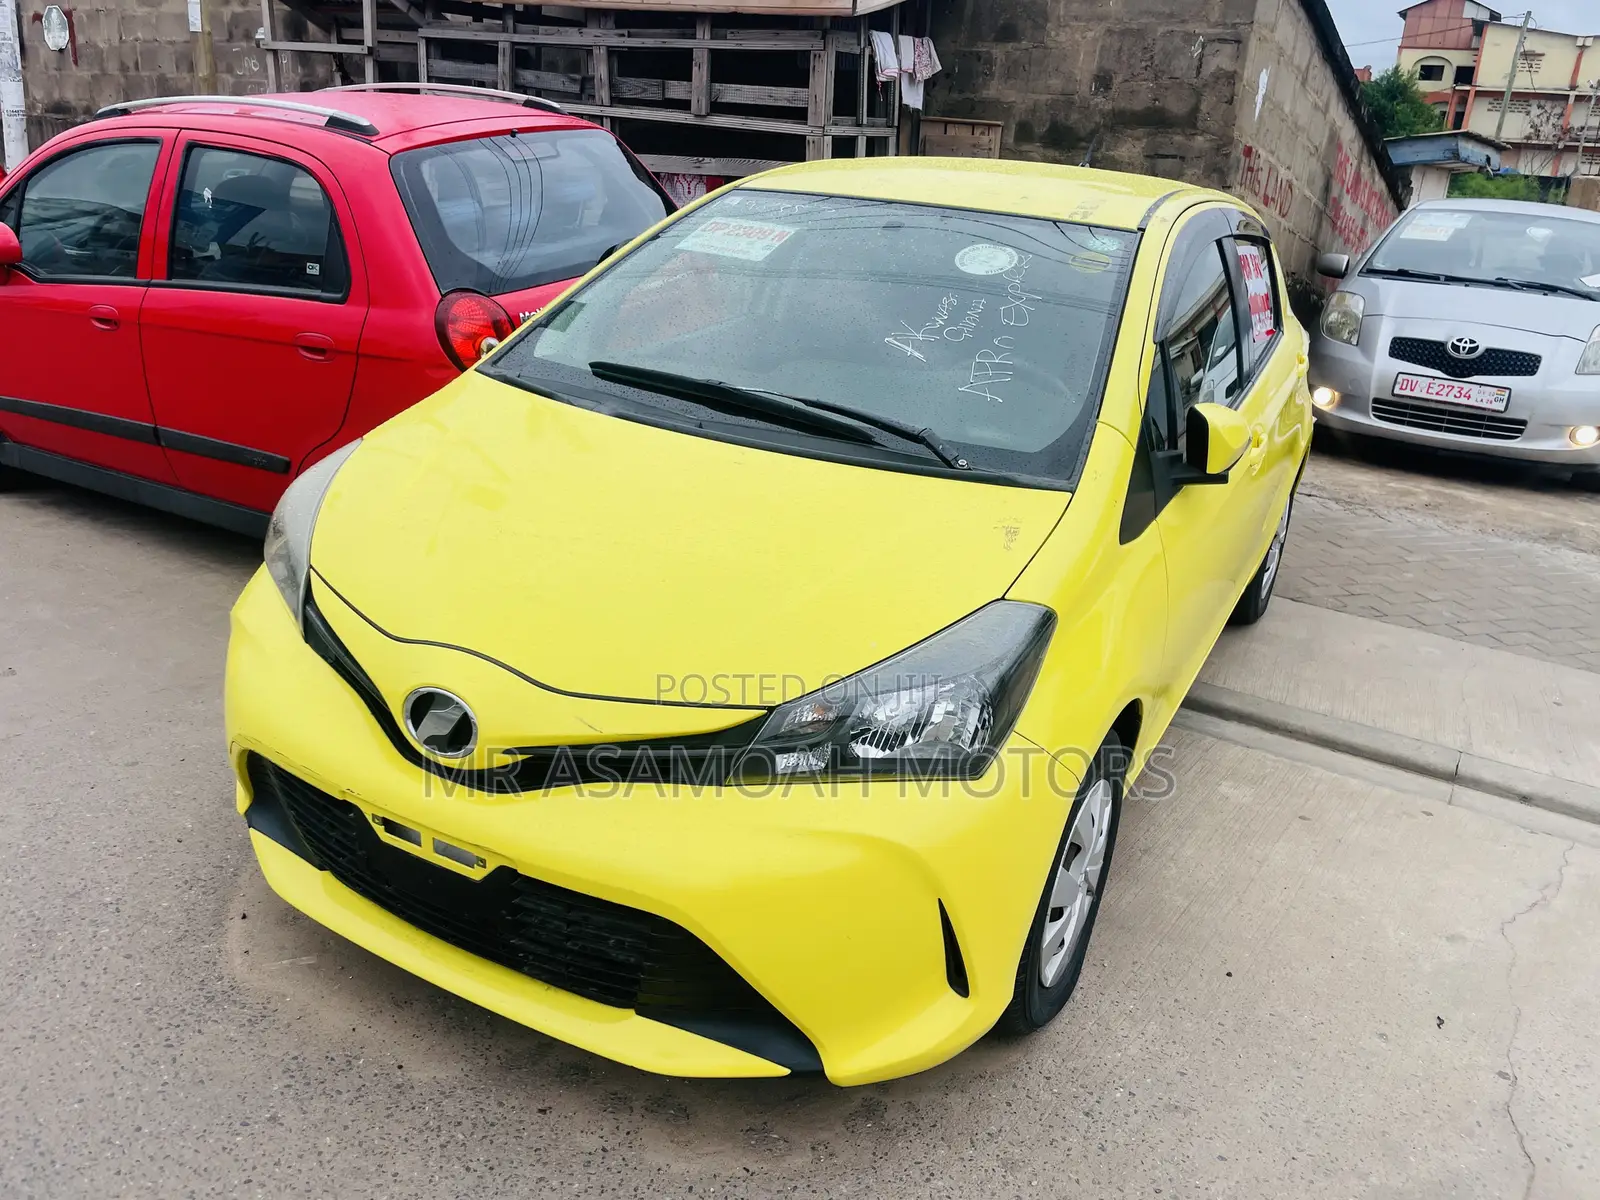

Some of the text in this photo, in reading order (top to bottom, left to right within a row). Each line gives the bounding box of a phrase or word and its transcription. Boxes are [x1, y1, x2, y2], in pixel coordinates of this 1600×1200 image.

[1263, 167, 1293, 218] LAND
[1399, 378, 1473, 401] DV E2734
[1494, 396, 1505, 404] GH
